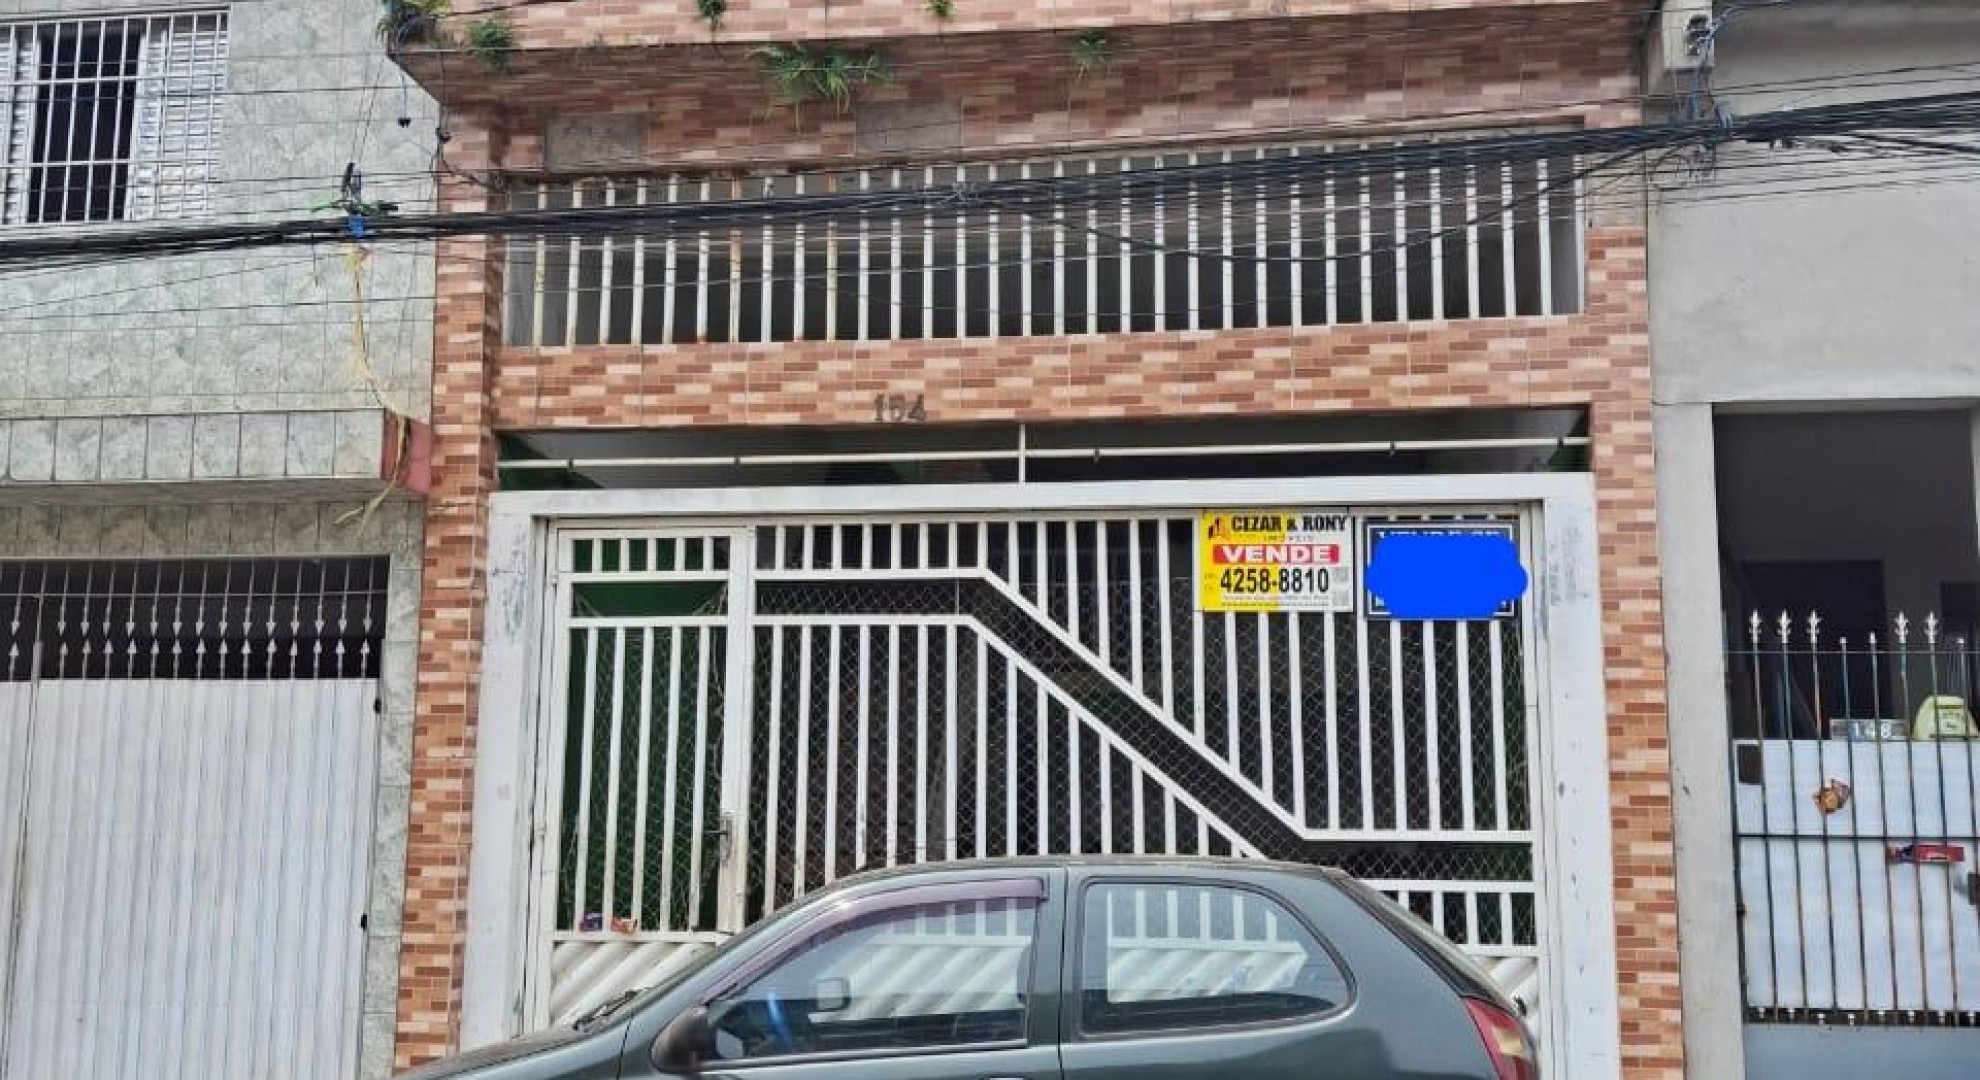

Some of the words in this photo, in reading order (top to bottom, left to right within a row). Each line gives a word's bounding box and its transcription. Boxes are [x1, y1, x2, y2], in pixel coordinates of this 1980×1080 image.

[1231, 515, 1282, 532] CEZAR
[1287, 516, 1298, 531] &
[1303, 515, 1348, 531] RONY
[1221, 545, 1331, 563] VENDE
[1220, 568, 1329, 593] 4258-8810
